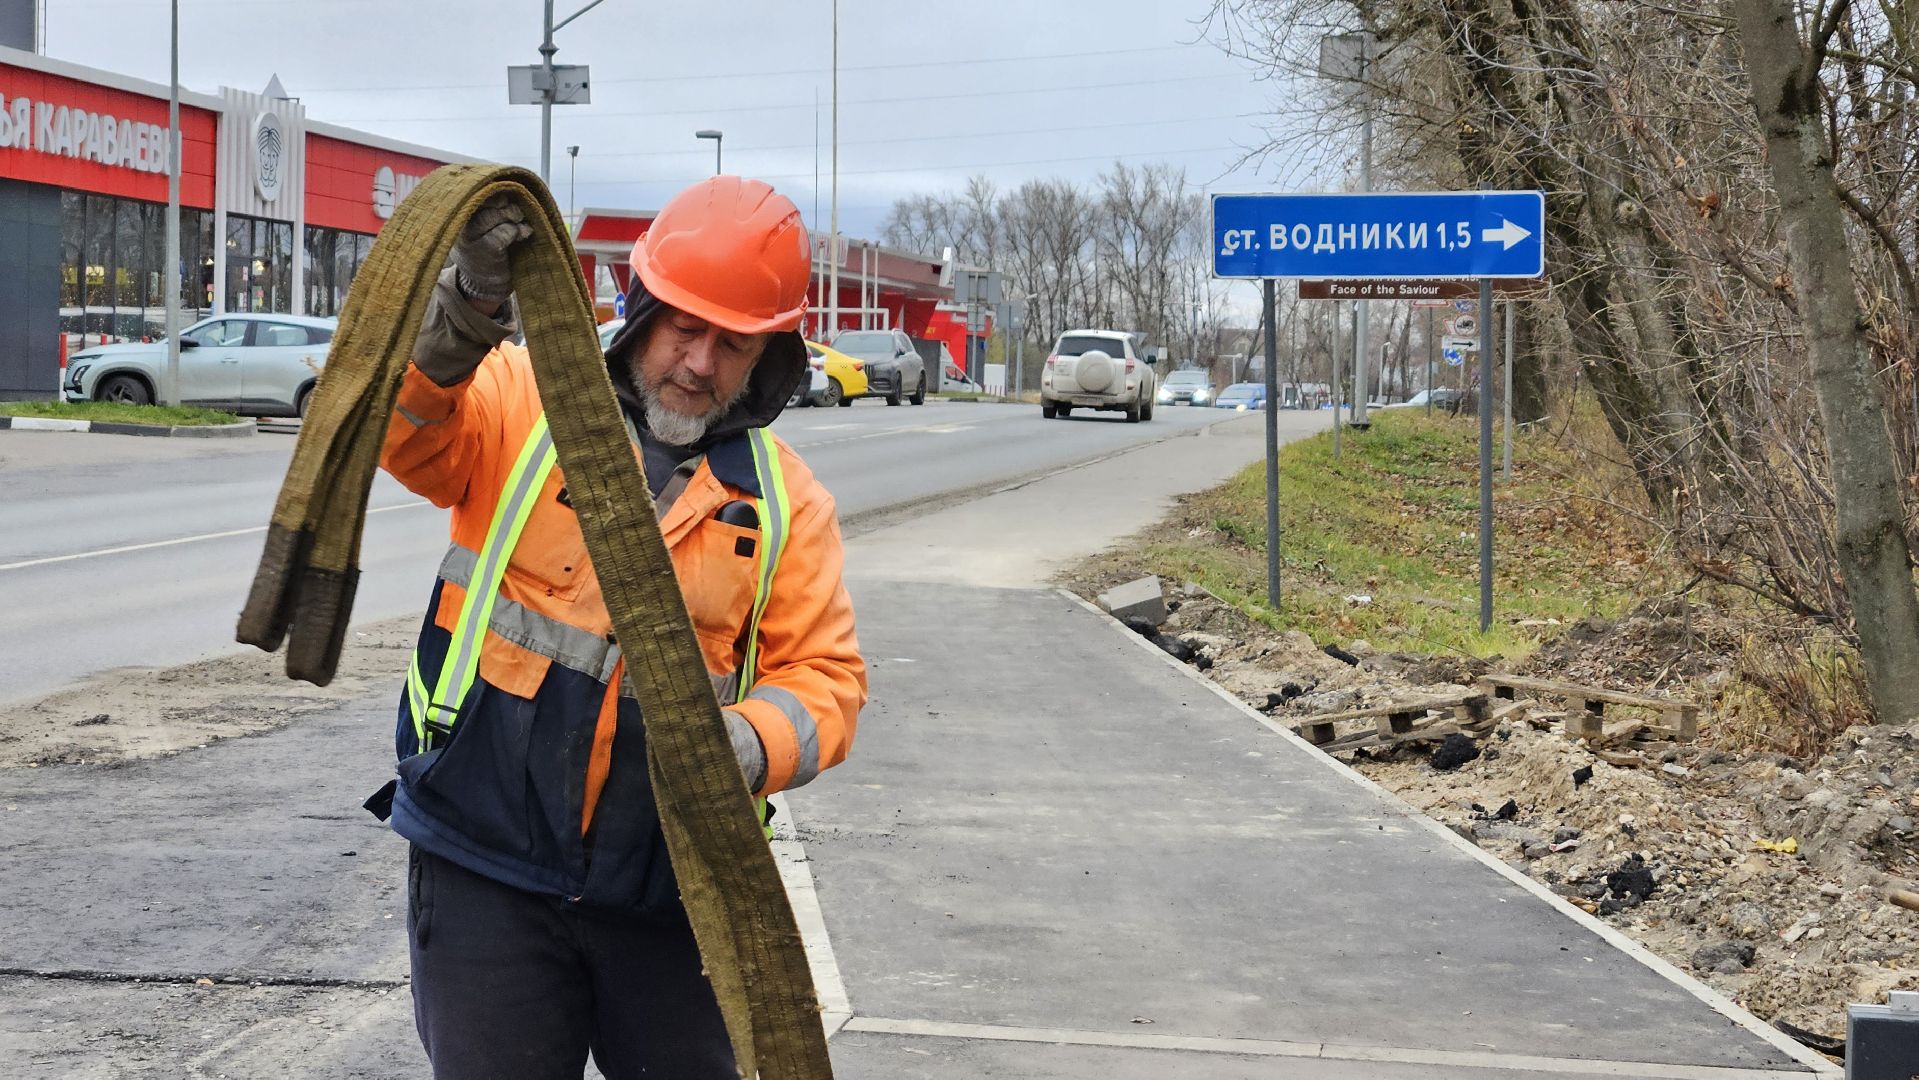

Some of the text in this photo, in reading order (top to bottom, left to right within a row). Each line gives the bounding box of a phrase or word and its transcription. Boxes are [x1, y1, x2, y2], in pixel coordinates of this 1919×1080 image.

[1269, 222, 1428, 254] ВОДНИКИ
[1437, 222, 1472, 252] 1,5
[1330, 284, 1440, 294] Face of the Saviour
